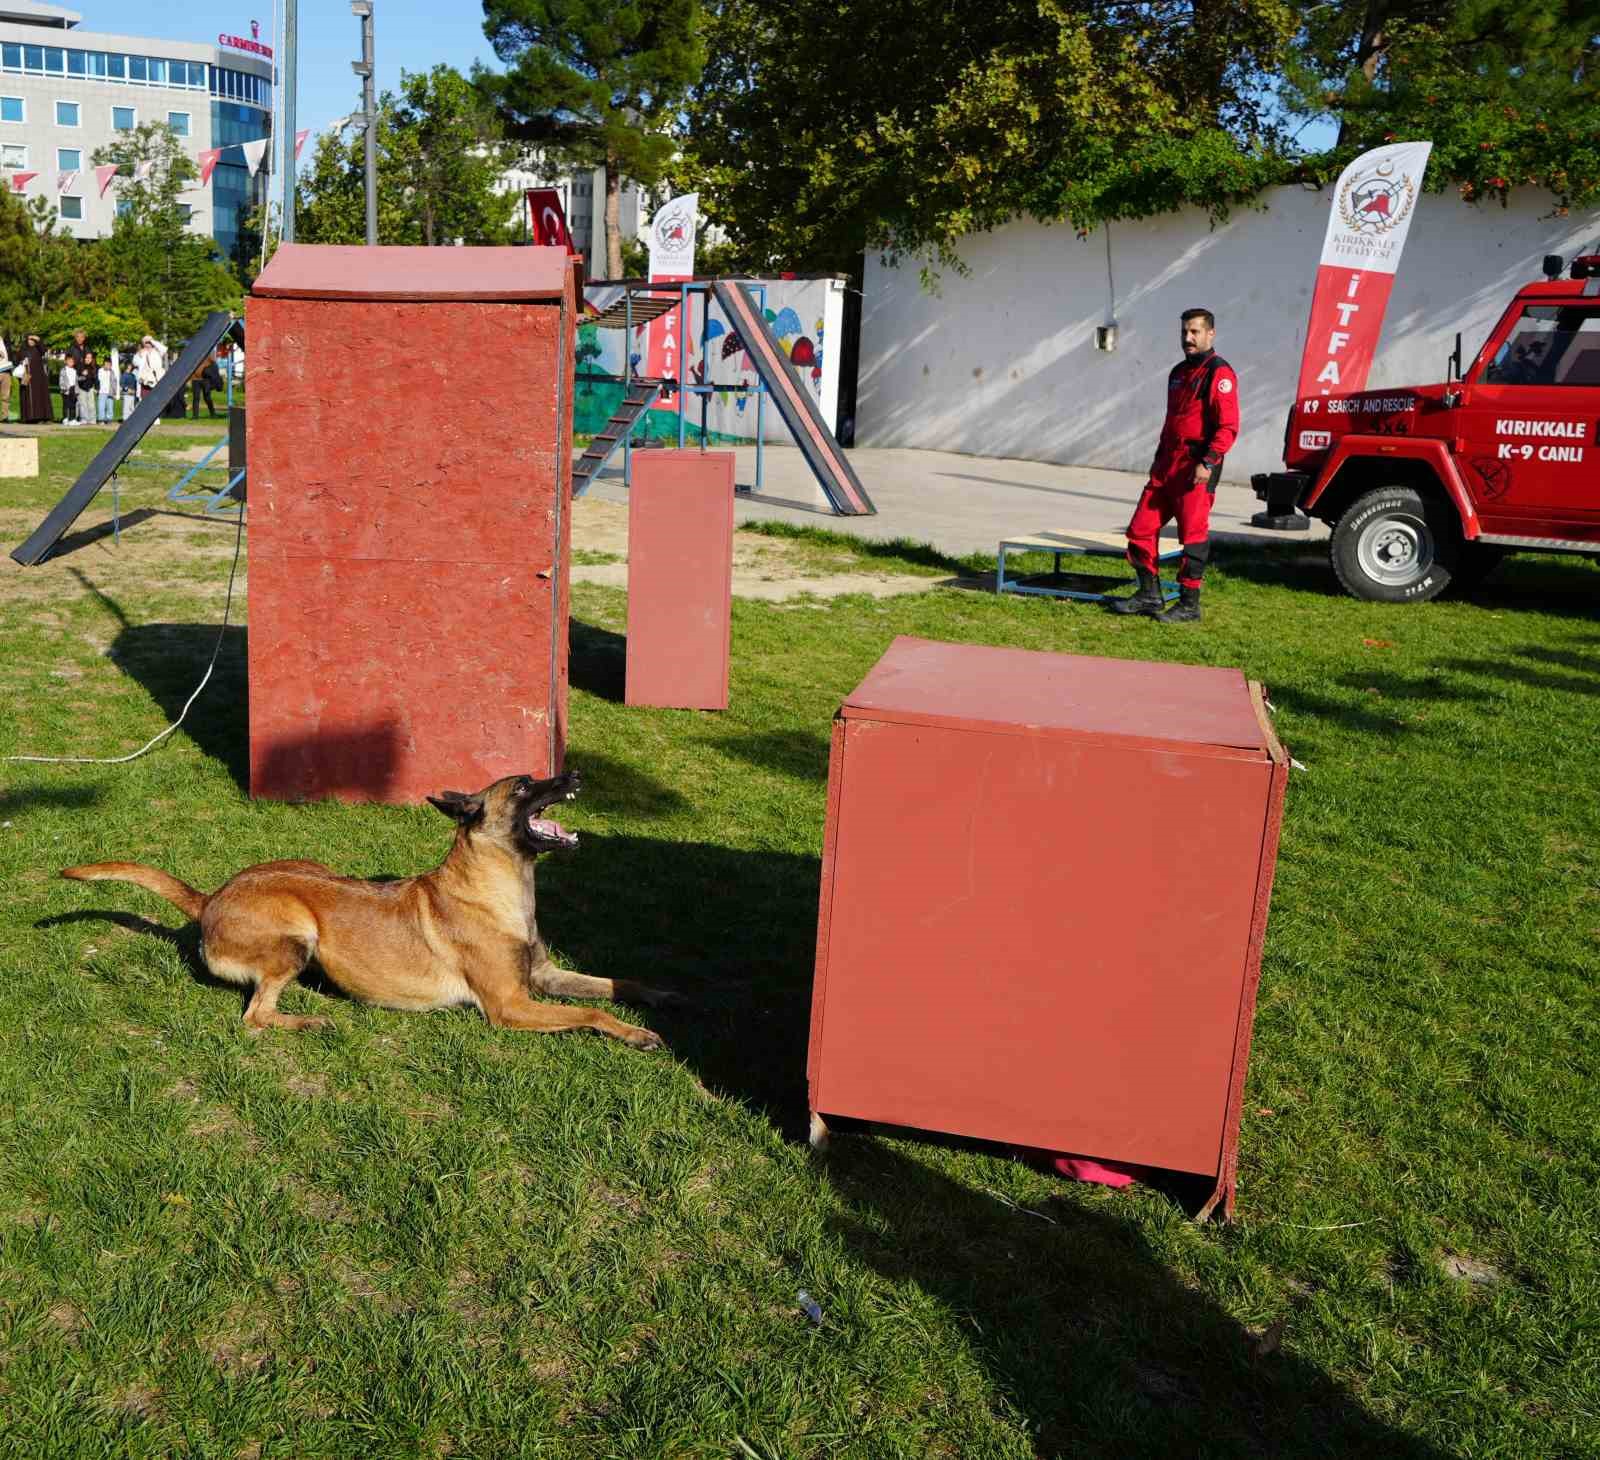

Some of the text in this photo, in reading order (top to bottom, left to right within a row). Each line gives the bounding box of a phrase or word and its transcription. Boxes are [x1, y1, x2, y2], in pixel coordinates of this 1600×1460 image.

[1316, 273, 1361, 396] İTFA
[1303, 398, 1415, 413] K9 SEARCH AND RESCUE
[1496, 419, 1586, 438] KIRIKKALE
[1497, 443, 1584, 463] K-9 CANLI
